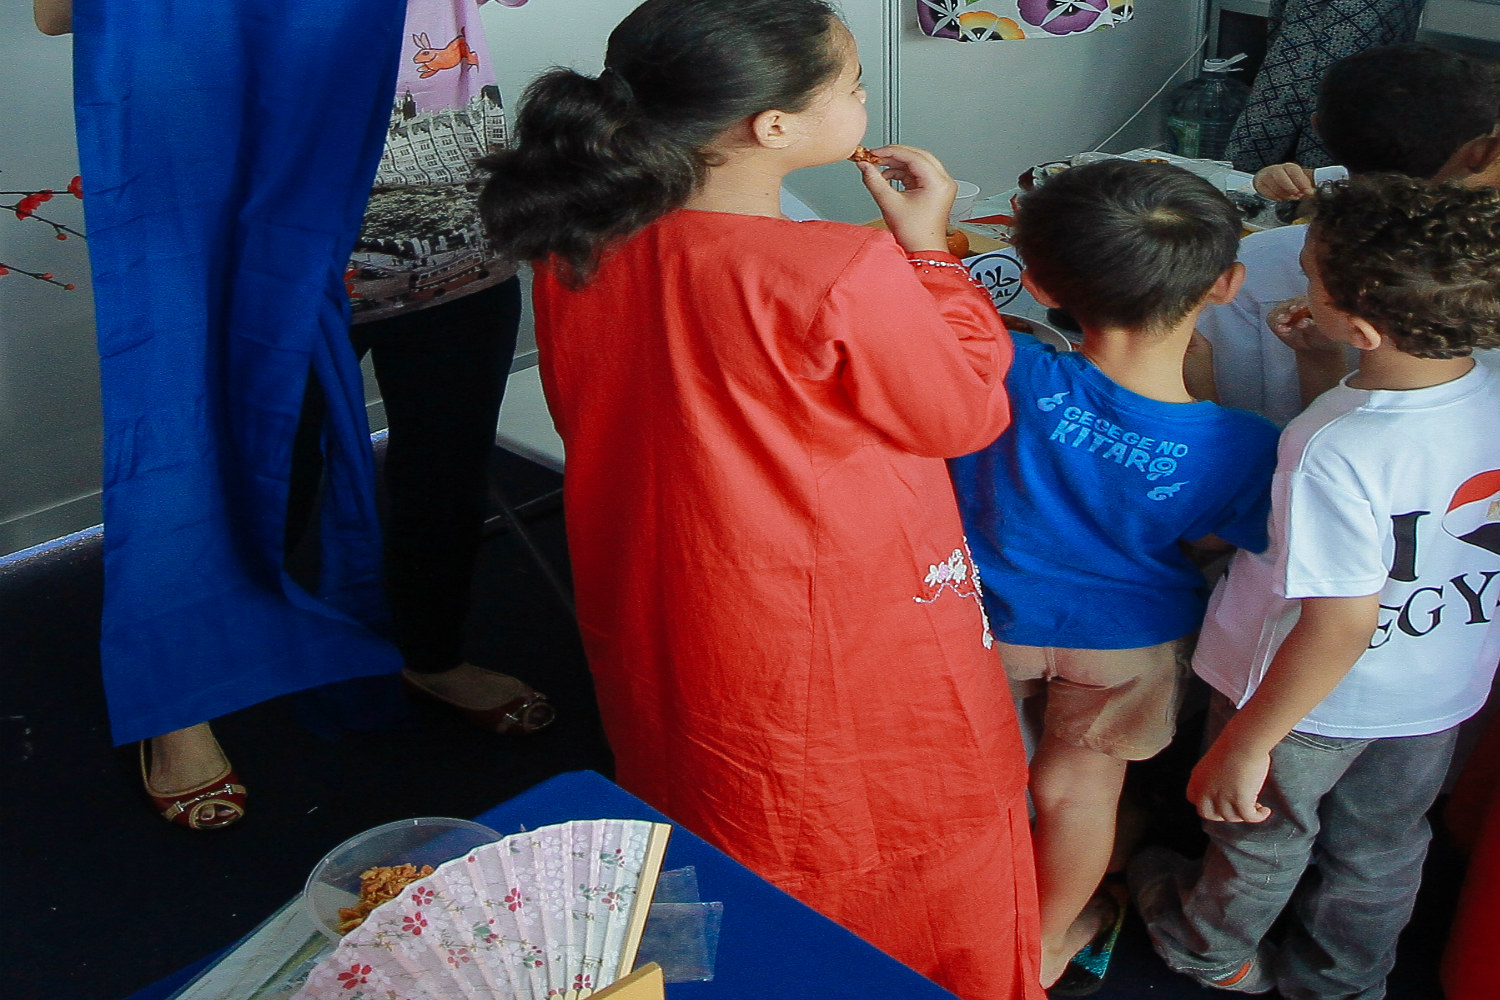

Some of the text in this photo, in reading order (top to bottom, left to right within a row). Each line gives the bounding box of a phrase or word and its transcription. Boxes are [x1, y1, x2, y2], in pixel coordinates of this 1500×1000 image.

[1049, 419, 1177, 480] KITARO
[1063, 406, 1189, 457] GEGEGE NO
[1388, 511, 1431, 582] I
